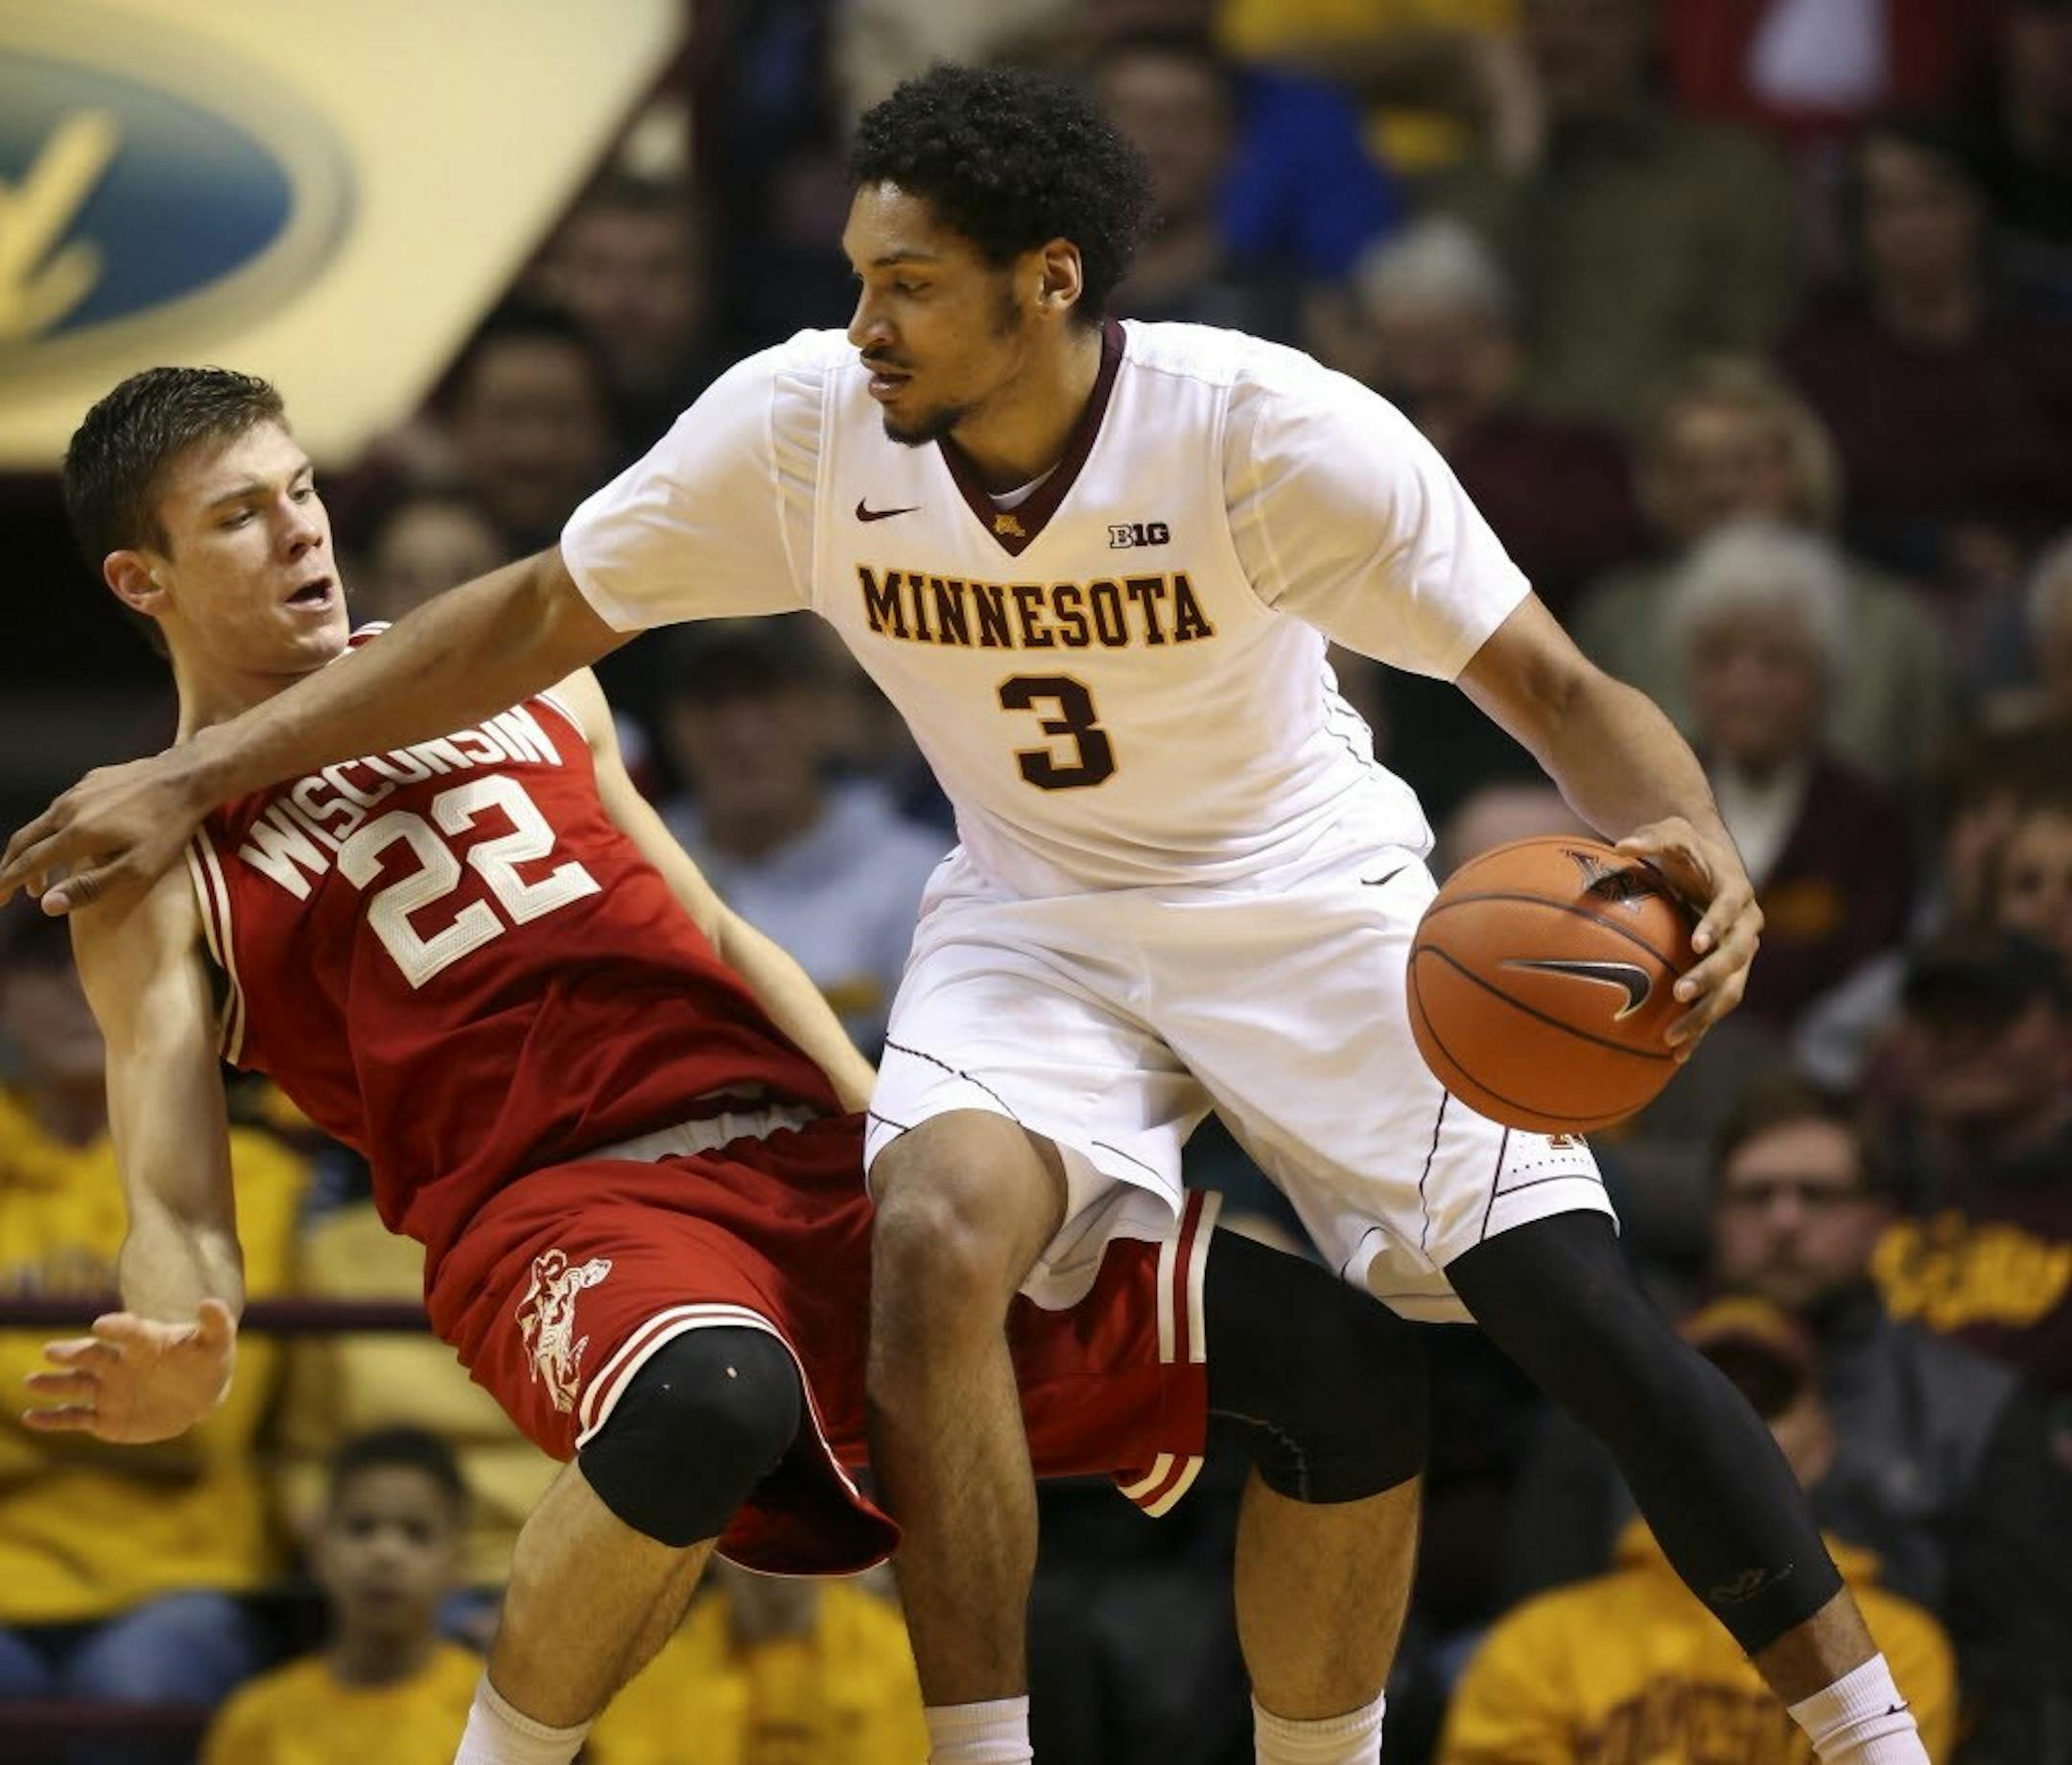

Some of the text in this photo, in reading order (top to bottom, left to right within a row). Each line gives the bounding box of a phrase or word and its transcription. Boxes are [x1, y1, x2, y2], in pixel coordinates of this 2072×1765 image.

[856, 563, 1216, 650] MINNESOTA
[997, 673, 1118, 790] 3
[338, 773, 602, 990] 22
